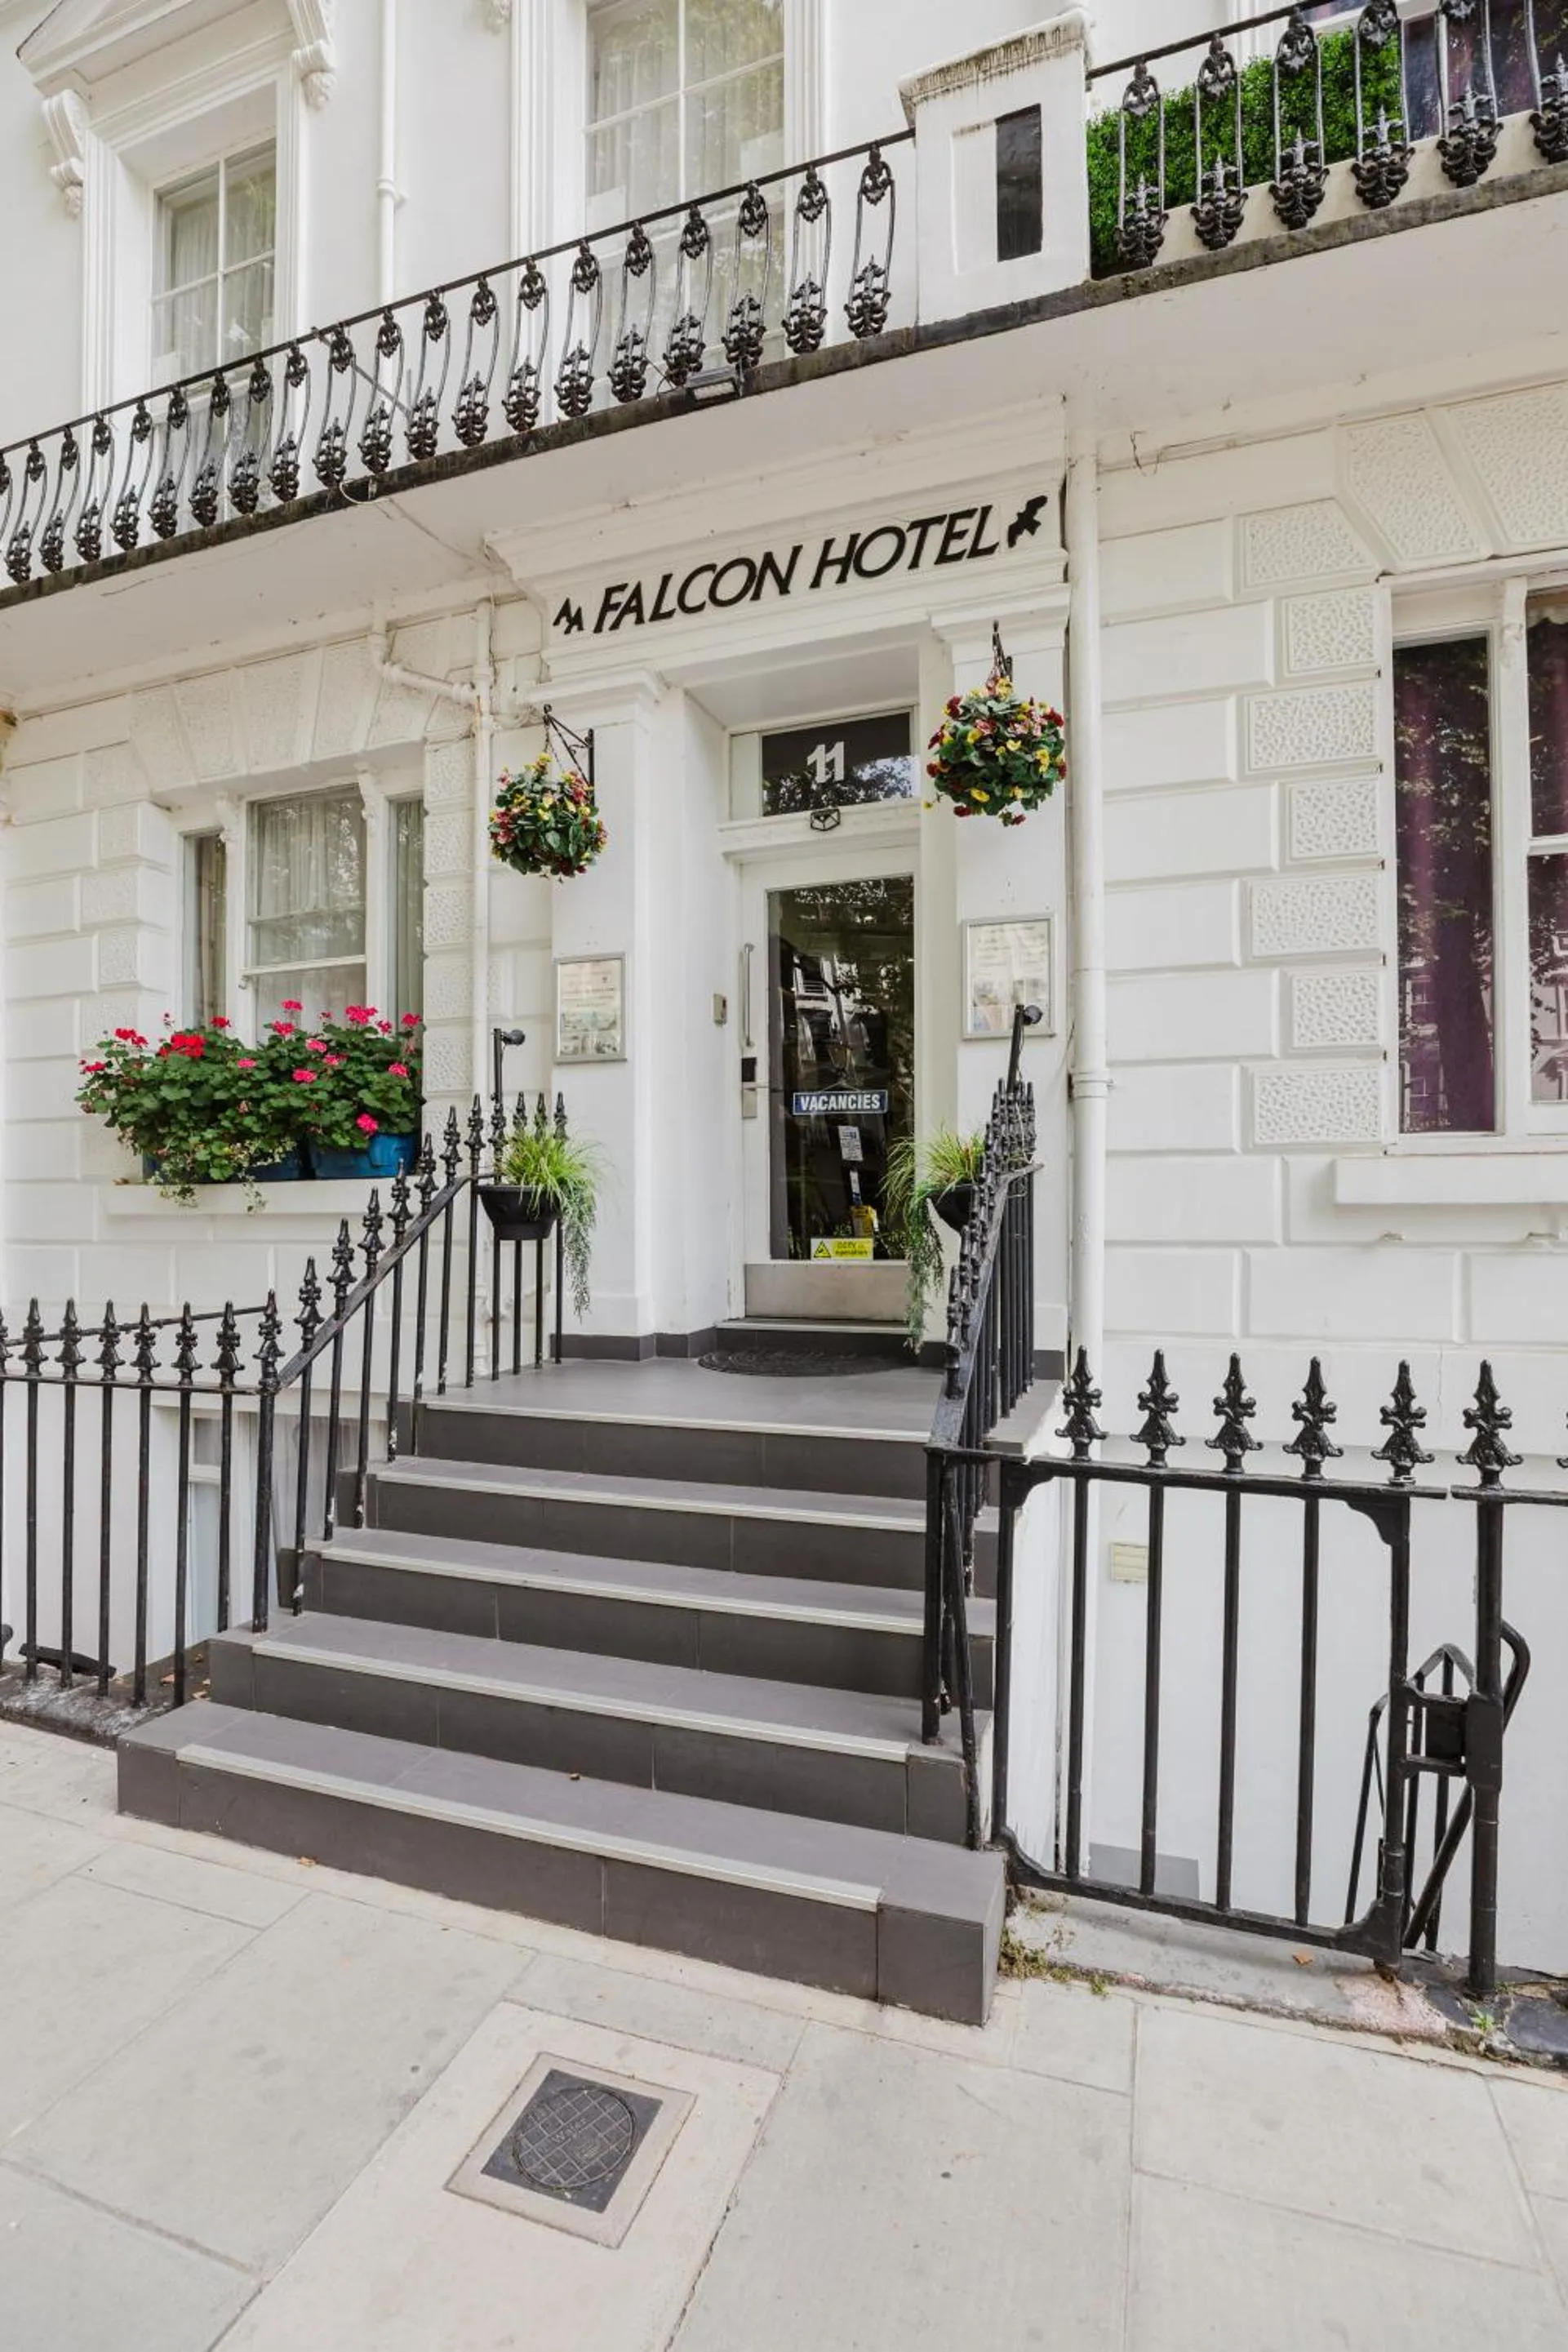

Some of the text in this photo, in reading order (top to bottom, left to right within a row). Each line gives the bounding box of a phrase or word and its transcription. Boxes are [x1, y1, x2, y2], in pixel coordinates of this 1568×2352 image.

[593, 505, 1000, 634] FALCON HOTEL
[806, 741, 845, 784] 11
[801, 1094, 881, 1111] VACANCIES
